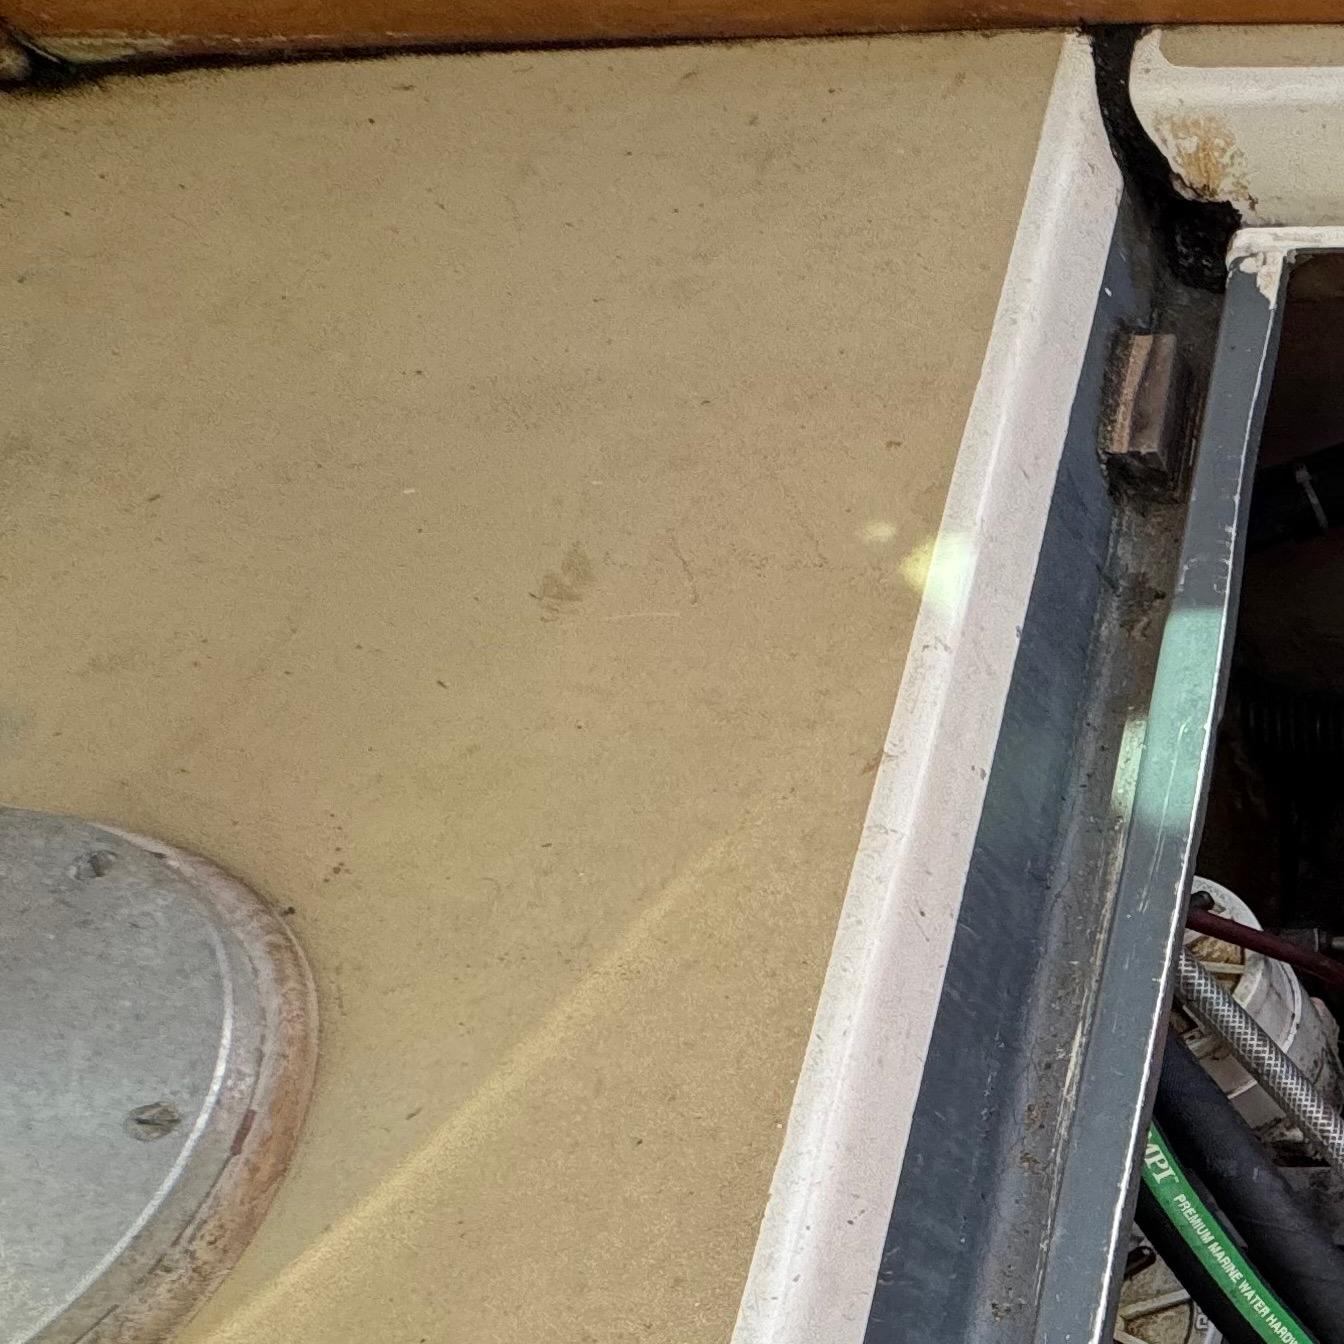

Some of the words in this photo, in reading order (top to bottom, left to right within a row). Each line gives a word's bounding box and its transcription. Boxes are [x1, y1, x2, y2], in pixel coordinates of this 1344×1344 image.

[1172, 1192, 1215, 1244] PREMIUM
[1206, 1240, 1245, 1284] MARINE
[1235, 1278, 1271, 1317] WATER
